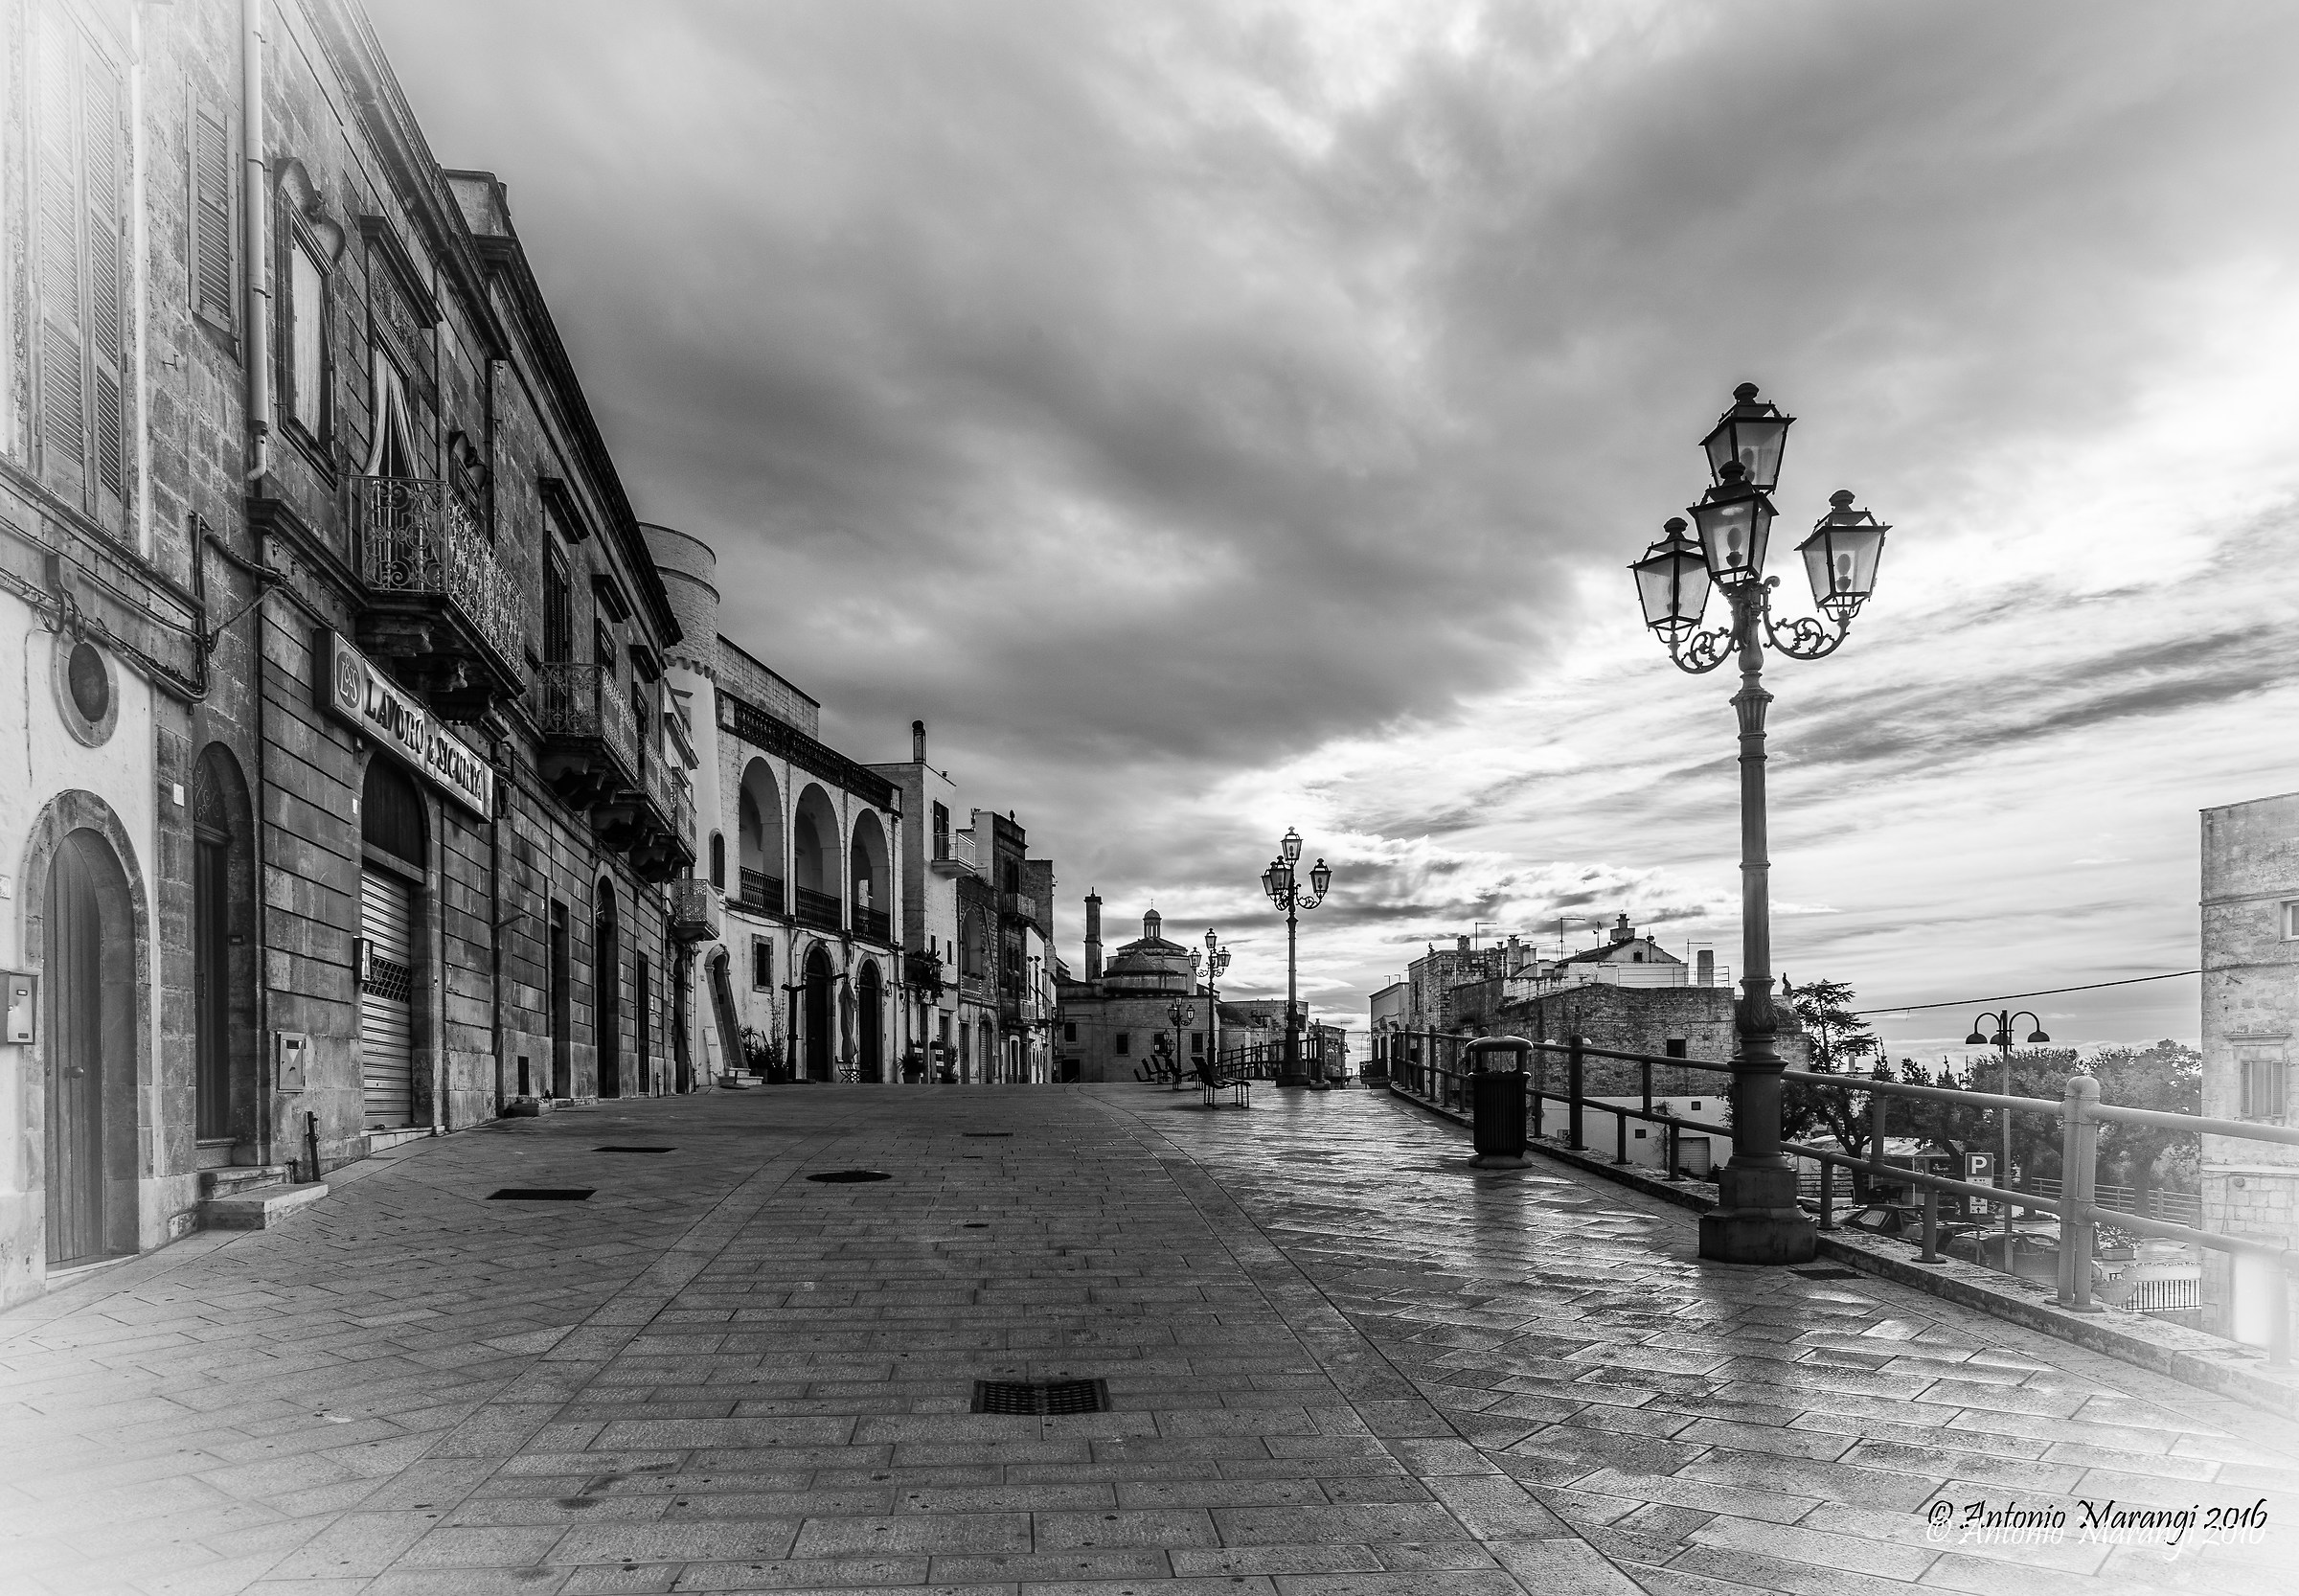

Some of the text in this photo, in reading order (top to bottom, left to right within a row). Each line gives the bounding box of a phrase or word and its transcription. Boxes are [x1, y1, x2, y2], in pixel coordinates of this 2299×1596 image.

[340, 655, 358, 704] L&S
[364, 678, 424, 754] LAVORO
[427, 734, 435, 764] &
[1971, 1155, 1988, 1174] P
